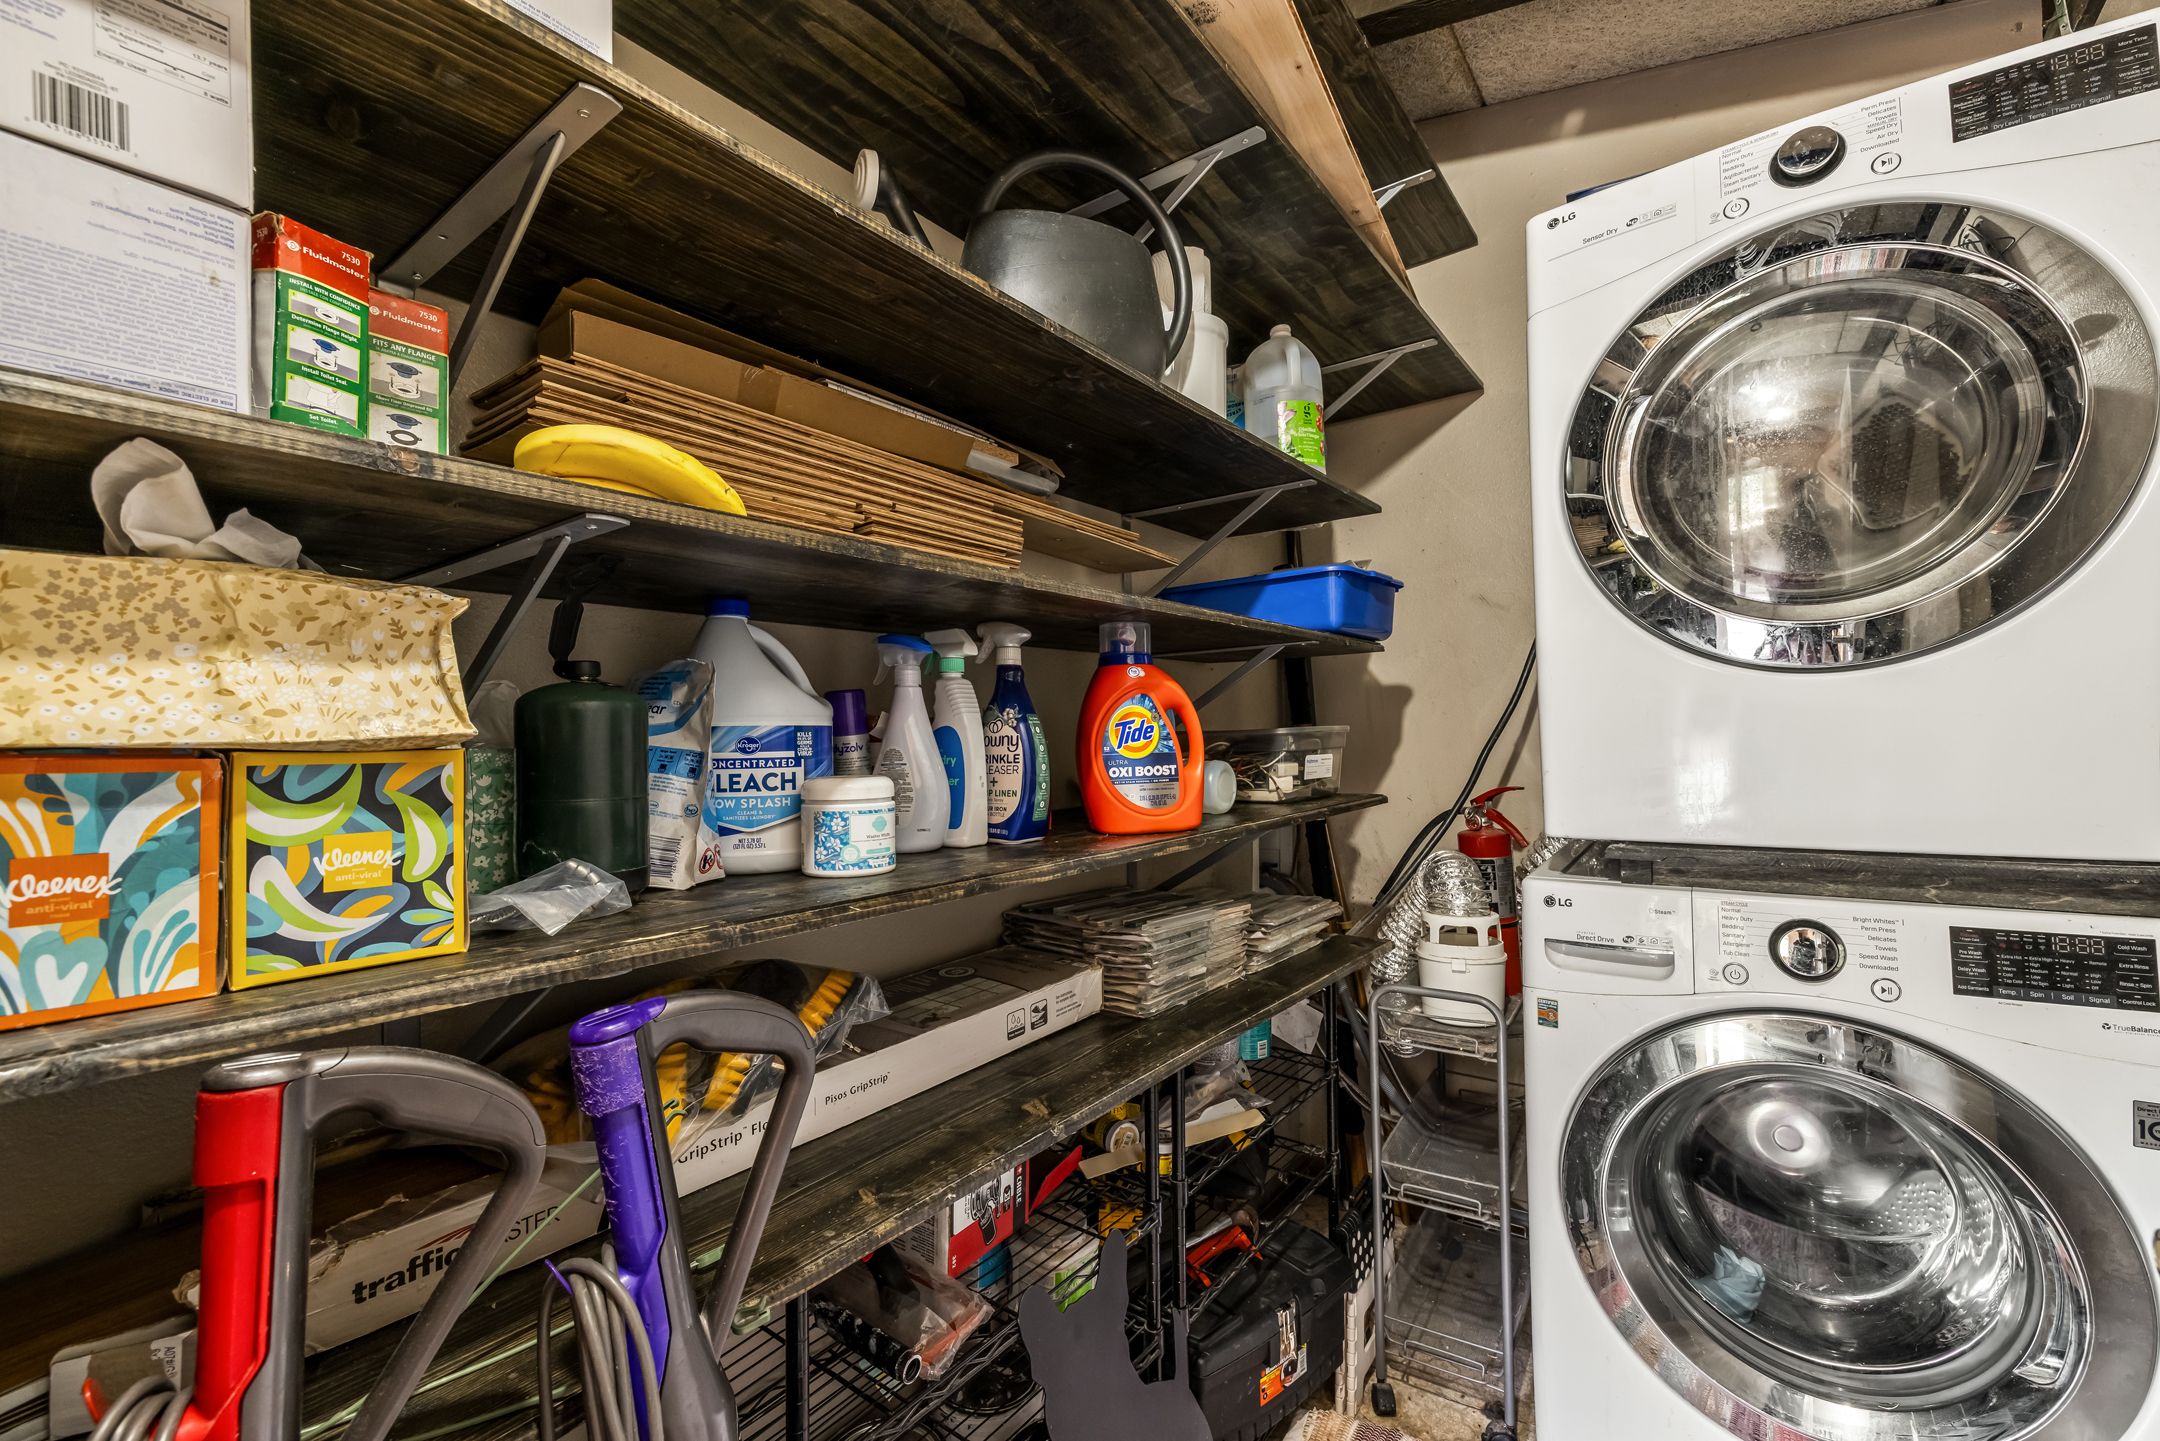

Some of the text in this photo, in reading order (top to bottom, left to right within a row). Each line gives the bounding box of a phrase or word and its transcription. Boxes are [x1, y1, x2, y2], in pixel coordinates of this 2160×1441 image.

[2118, 37, 2132, 46] More
[2119, 69, 2140, 77] Wrinkle
[2089, 94, 2111, 104] Signal
[1868, 106, 1896, 117] Delicates
[2055, 102, 2082, 113] Time Dry
[1876, 112, 1897, 121] Towels
[2005, 118, 2020, 127] Level
[1866, 126, 1885, 134] Speed
[1958, 129, 1976, 137] Custom
[1860, 138, 1899, 152] Downloaded
[1722, 149, 1742, 159] Normal
[1723, 157, 1739, 166] Heavy
[1722, 163, 1745, 173] Bedding
[1724, 165, 1759, 180] Antibacterial
[1724, 179, 1739, 188] Steam
[1724, 187, 1741, 196] Steam
[1562, 212, 1576, 224] LG
[1582, 227, 1618, 244] Sensor Dry
[341, 251, 360, 266] 7530
[289, 278, 312, 290] INSTALL
[314, 286, 328, 296] WITH
[329, 291, 361, 310] CONFIDENCE
[419, 310, 438, 322] 7530
[372, 338, 389, 348] FITS
[391, 344, 406, 353] ANY
[408, 347, 437, 362] FLANGE
[301, 366, 319, 376] Install
[320, 372, 335, 381] Toilet
[158, 386, 179, 395] SHOCK
[181, 392, 209, 402] ELECTRIC
[1115, 719, 1155, 750] Tide
[738, 740, 759, 752] Kroger
[985, 734, 1019, 752] owny
[712, 759, 795, 768] ONCENTRATED
[986, 754, 1020, 764] RINKLE
[1109, 764, 1177, 778] OXI BOOST
[715, 771, 797, 793] LEACH
[715, 797, 791, 809] OW SPLASH
[313, 848, 401, 876] Kleenex
[336, 870, 381, 881] anti-viral
[0, 873, 123, 910] Kleenex
[25, 900, 94, 914] anti-viral
[1558, 898, 1572, 907] LG
[1577, 934, 1596, 942] Direct
[1859, 963, 1899, 972] Downloaded
[825, 1090, 848, 1105] Pisos
[352, 1246, 462, 1305] traffic
